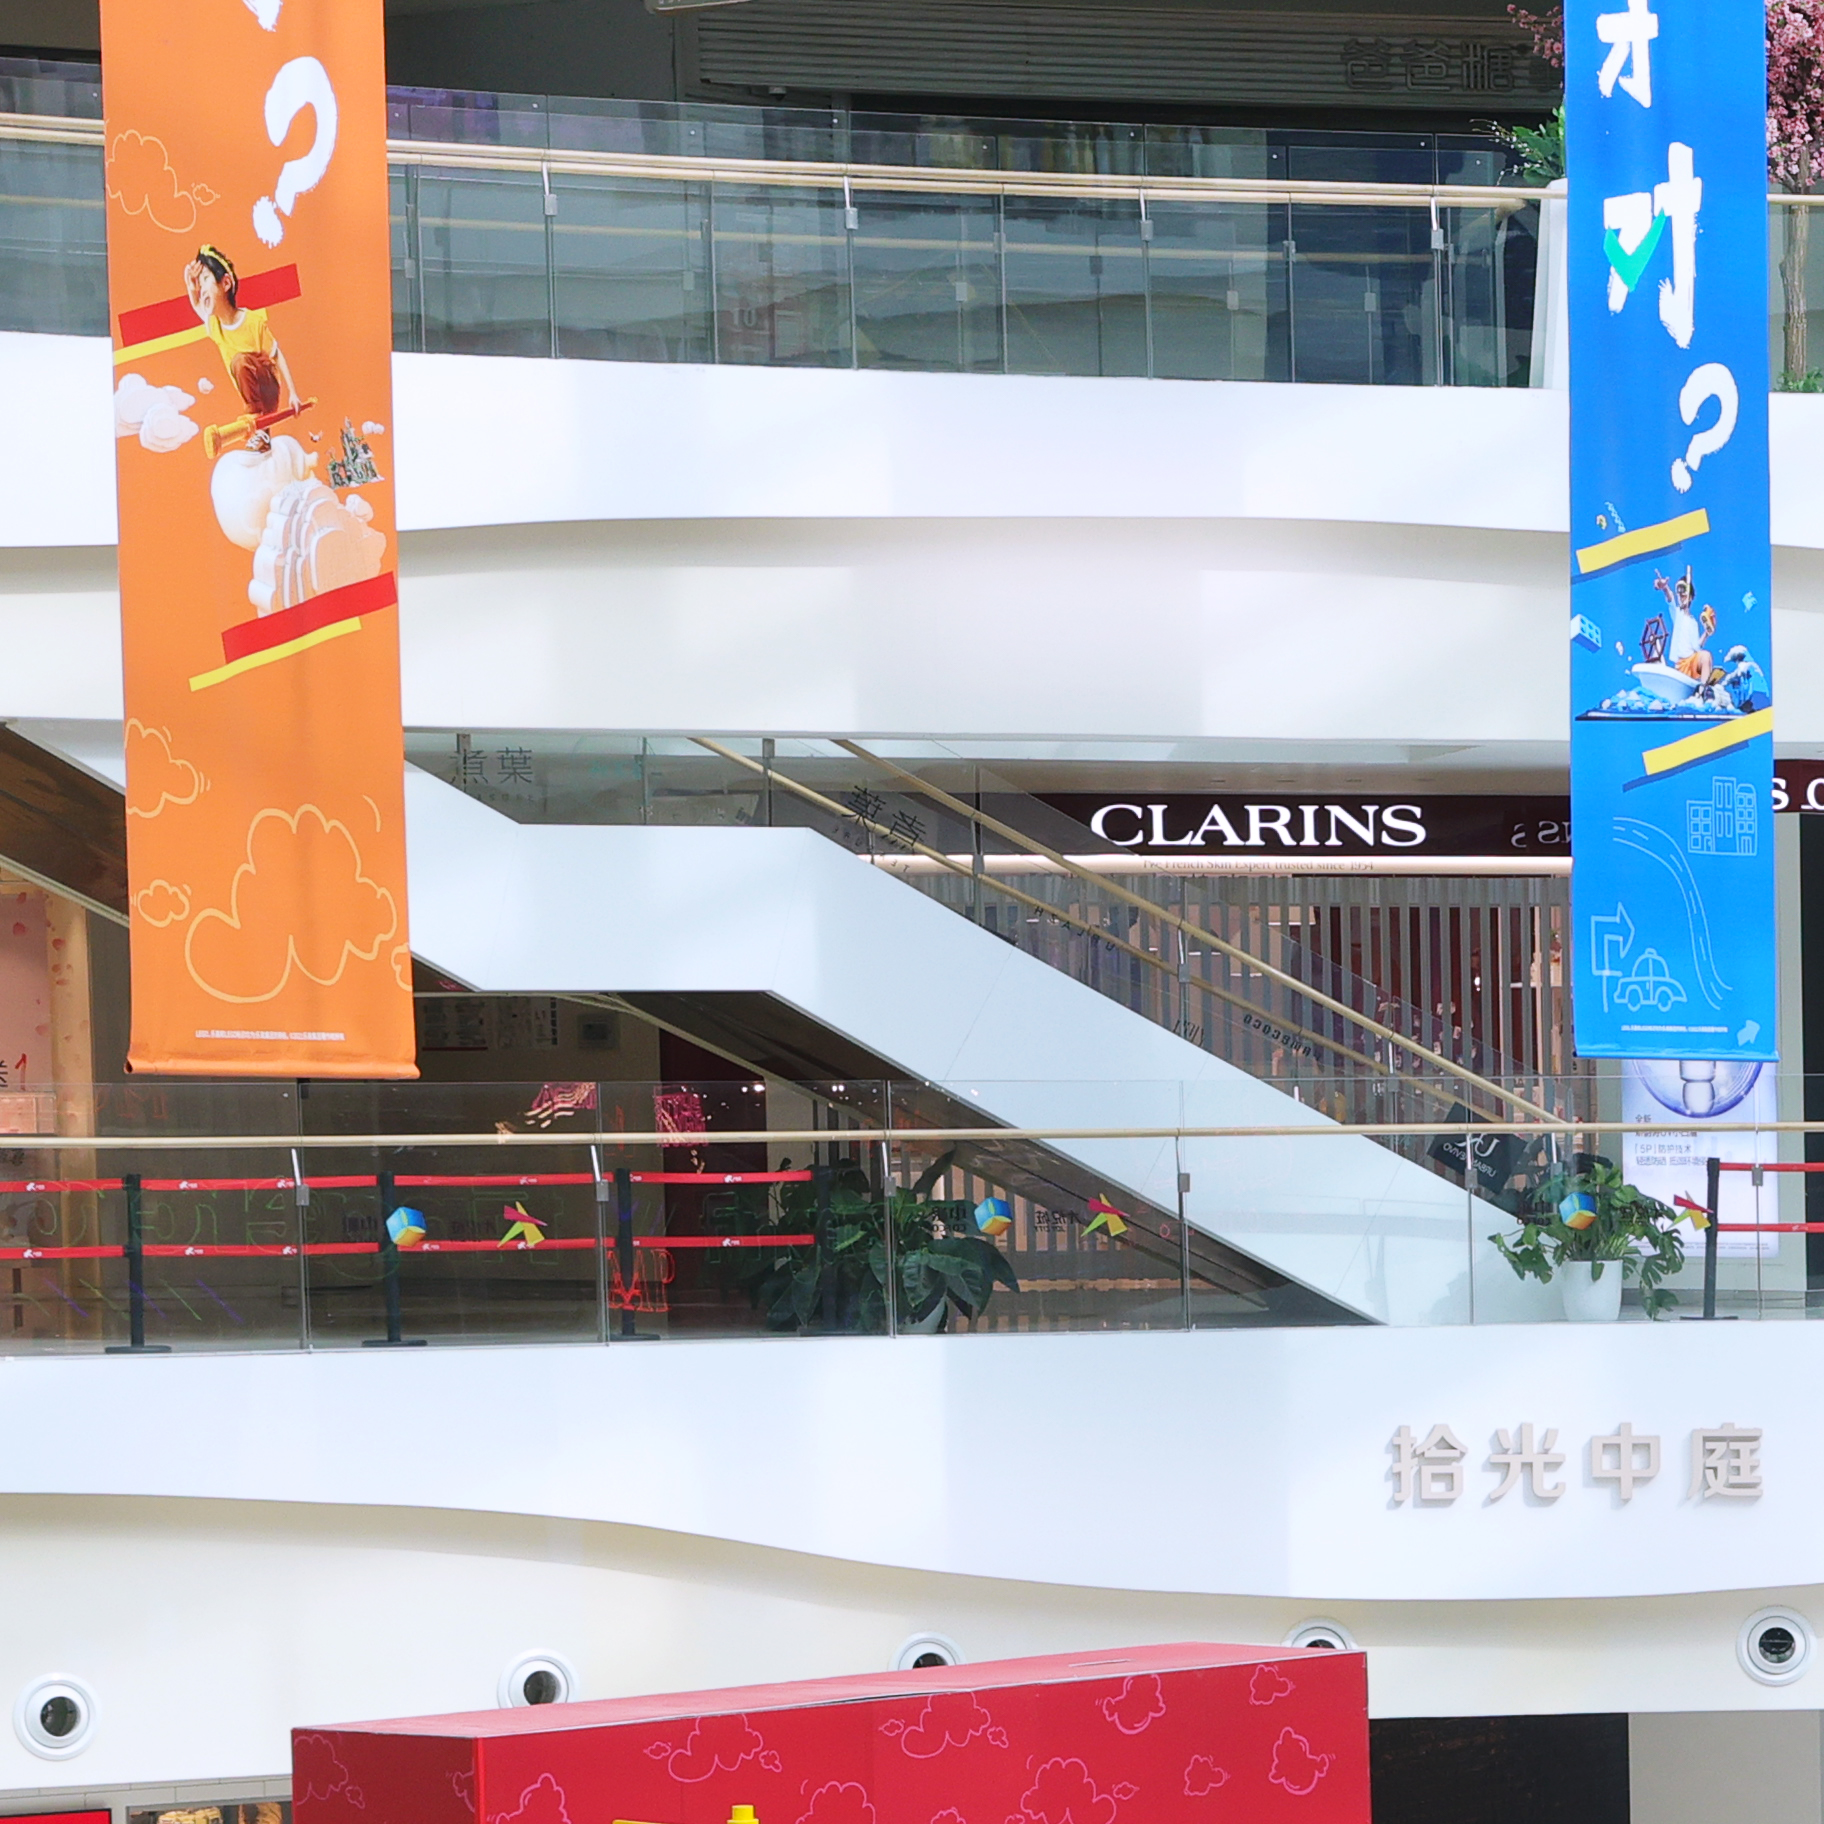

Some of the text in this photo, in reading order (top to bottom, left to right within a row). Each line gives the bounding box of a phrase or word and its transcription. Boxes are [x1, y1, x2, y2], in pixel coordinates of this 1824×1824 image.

[1090, 803, 1428, 848] CLARINS
[1389, 1419, 1767, 1509] 拾光中庭
